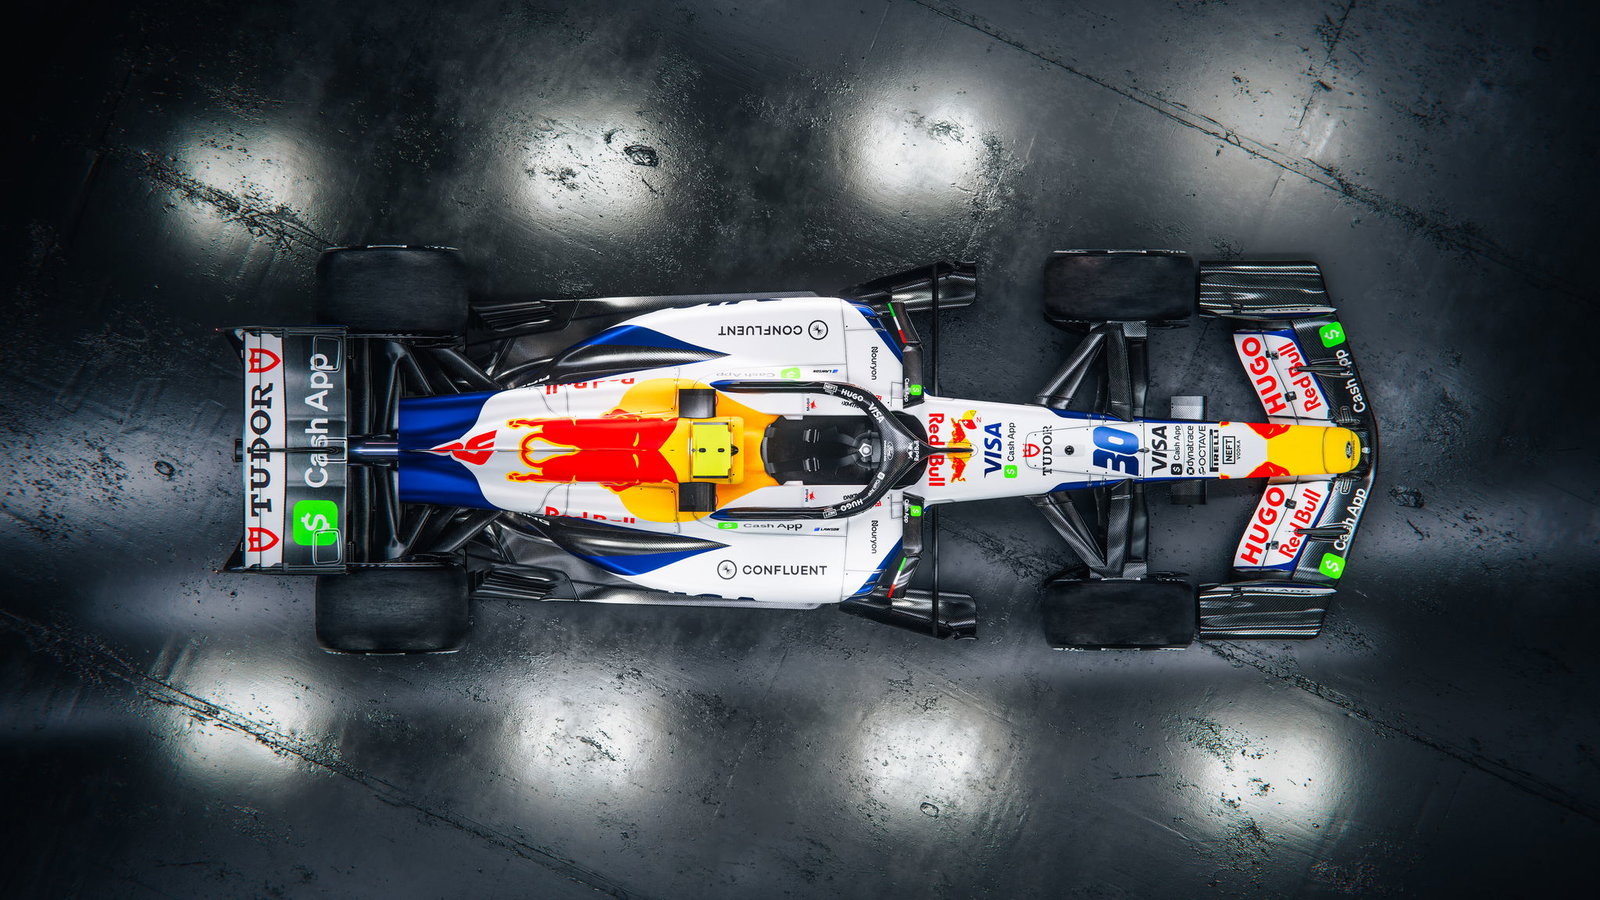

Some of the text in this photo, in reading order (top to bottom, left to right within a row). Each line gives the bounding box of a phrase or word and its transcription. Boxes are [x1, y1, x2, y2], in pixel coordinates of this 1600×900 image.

[718, 325, 803, 336] CONFLUENT
[870, 346, 879, 381] Nouryon
[1242, 336, 1287, 415] HUGO
[304, 352, 335, 413] App
[840, 388, 864, 402] HUGO
[1293, 375, 1322, 413] Red
[1345, 378, 1366, 413] Cash
[868, 401, 885, 423] VISA
[1007, 422, 1017, 440] App
[1173, 425, 1182, 441] App
[1186, 425, 1196, 467] dynatrace
[1198, 425, 1207, 466] OCTAVE
[250, 382, 274, 518] TUDOR
[304, 416, 329, 488] Cash
[928, 413, 945, 487] Red Bull
[983, 422, 1003, 479] VISA
[1006, 440, 1015, 462] Cash
[1042, 424, 1053, 477] TUDOR
[1092, 425, 1139, 477] 30
[1151, 425, 1168, 475] VISA
[1173, 442, 1181, 461] Cash
[1209, 428, 1219, 473] PIRELLI
[1225, 439, 1233, 462] NEFT
[840, 498, 864, 511] HUGO
[1347, 487, 1367, 515] App
[776, 522, 804, 532] App
[870, 519, 879, 555] Nouryon
[1240, 486, 1286, 566] HUGO
[1278, 488, 1322, 559] Red Bull
[742, 565, 828, 576] CONFLUENT
